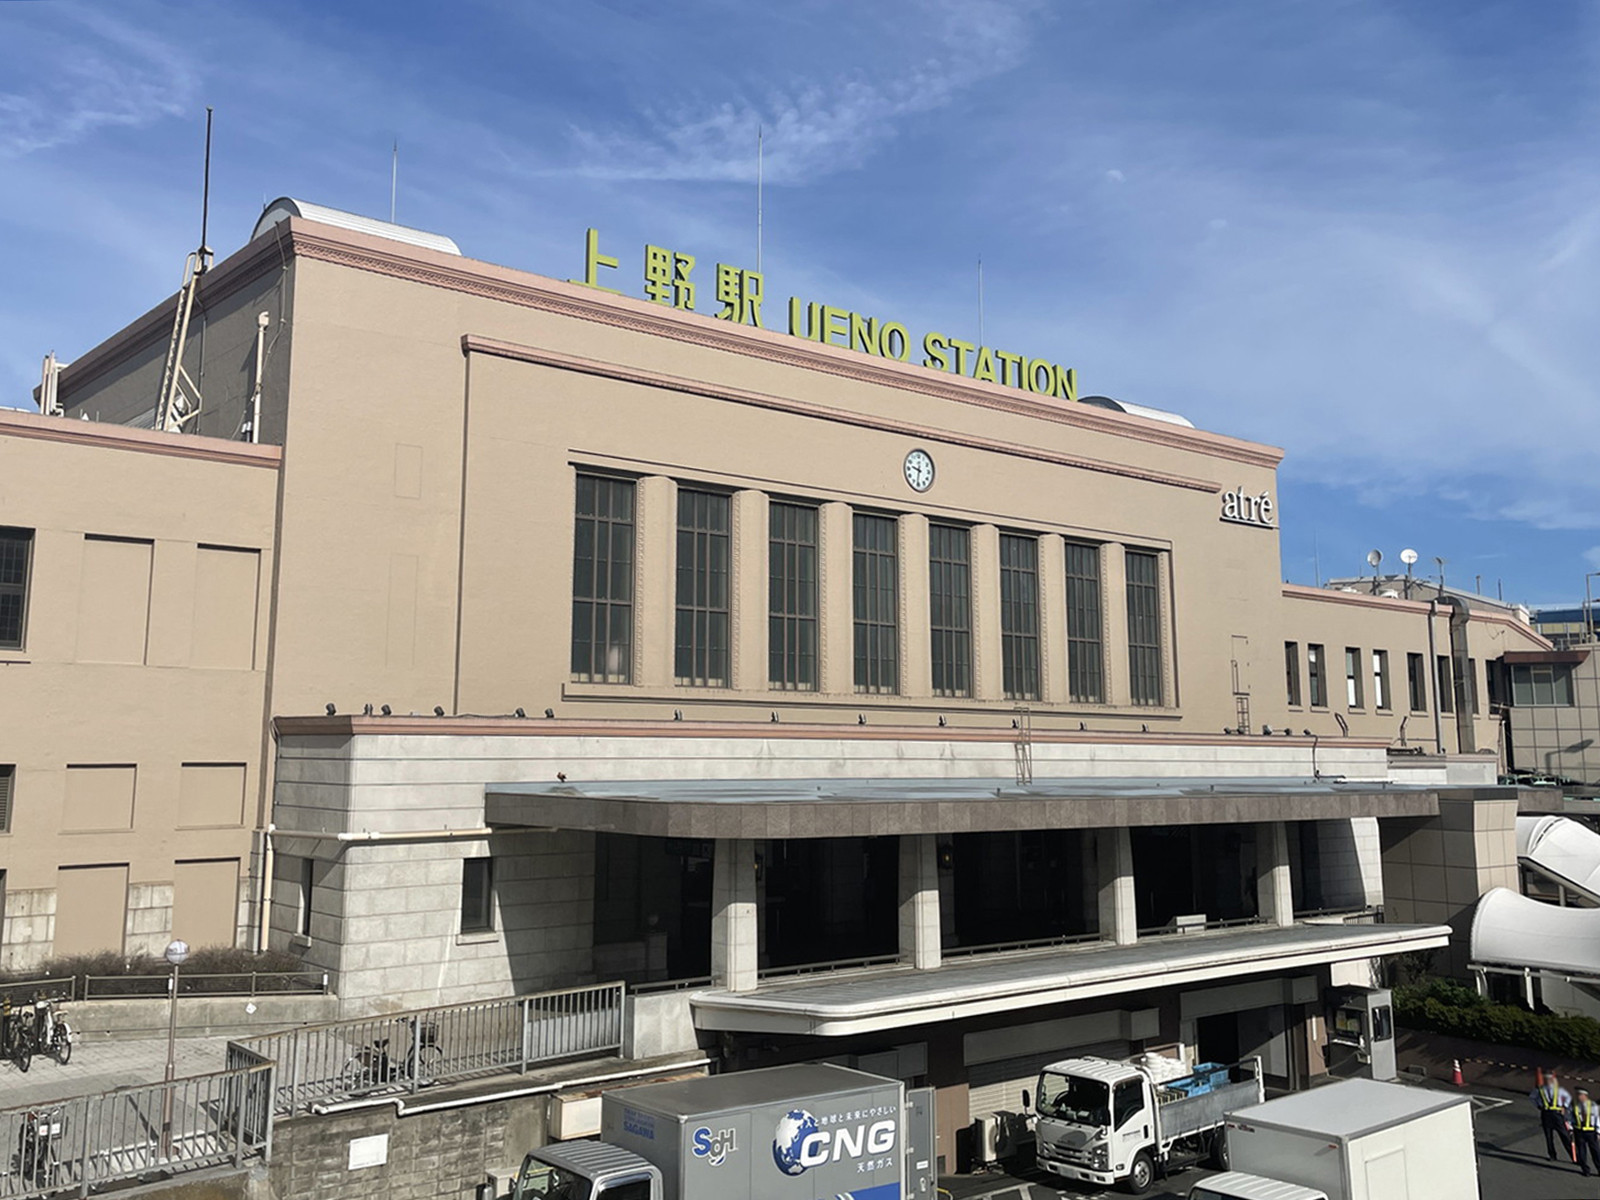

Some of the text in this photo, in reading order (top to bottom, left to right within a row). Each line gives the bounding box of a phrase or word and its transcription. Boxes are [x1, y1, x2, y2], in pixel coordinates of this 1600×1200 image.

[567, 228, 764, 328] 上野駅
[789, 297, 1078, 402] UENO STATION
[800, 1120, 896, 1168] CNG
[856, 1158, 893, 1173] 天然ガス
